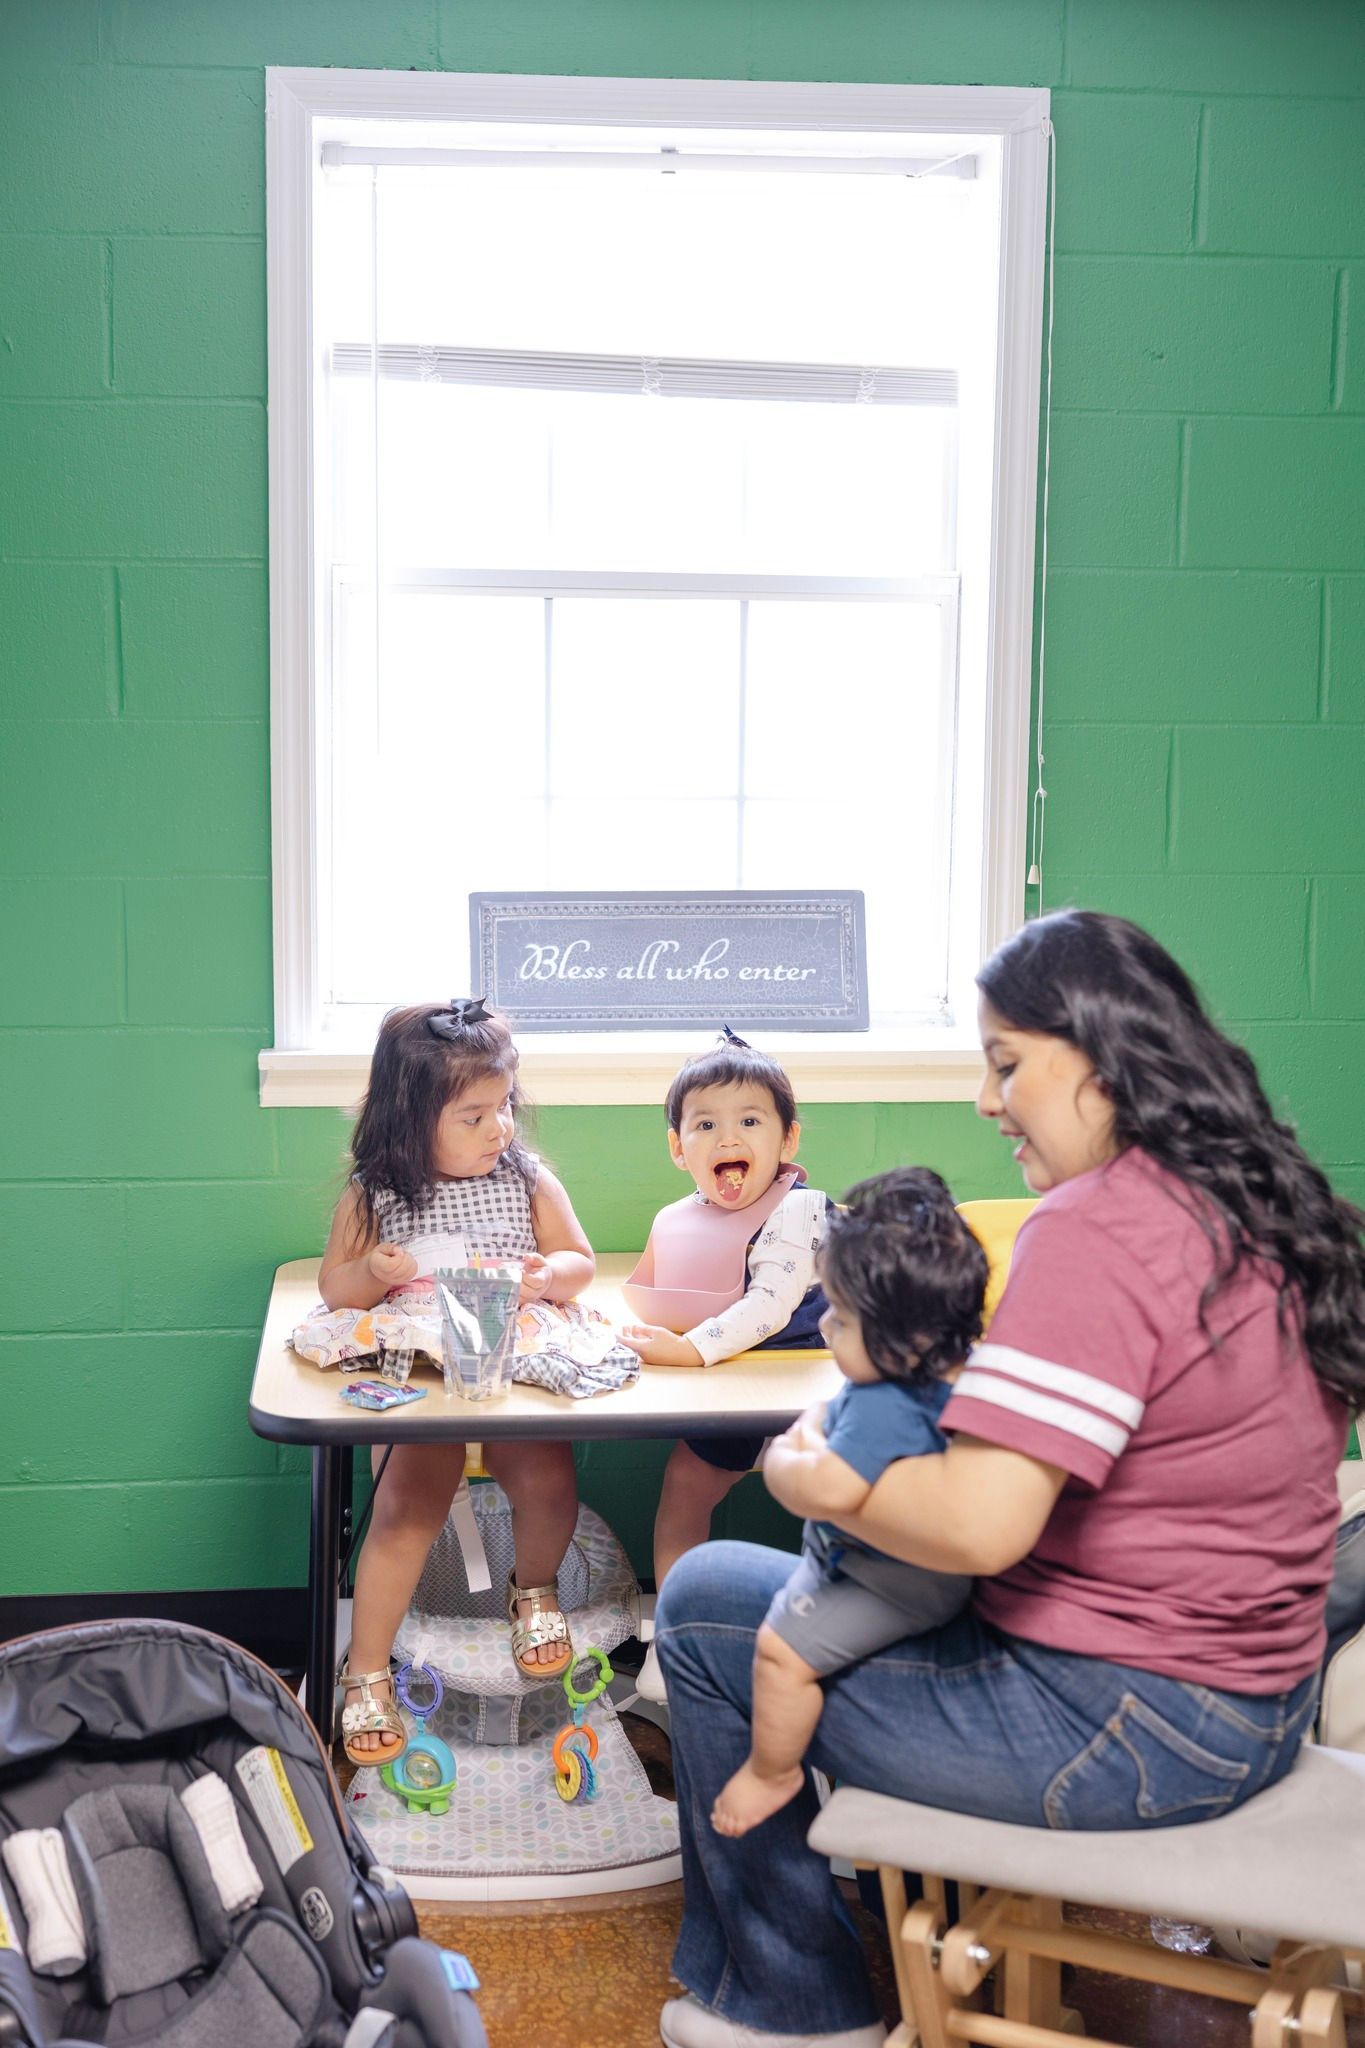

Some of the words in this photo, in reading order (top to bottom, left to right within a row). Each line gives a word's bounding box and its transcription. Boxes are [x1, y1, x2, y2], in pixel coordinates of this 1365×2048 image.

[519, 939, 608, 981] Bless
[616, 939, 680, 980] all
[665, 937, 730, 981] who
[738, 964, 817, 982] enter
